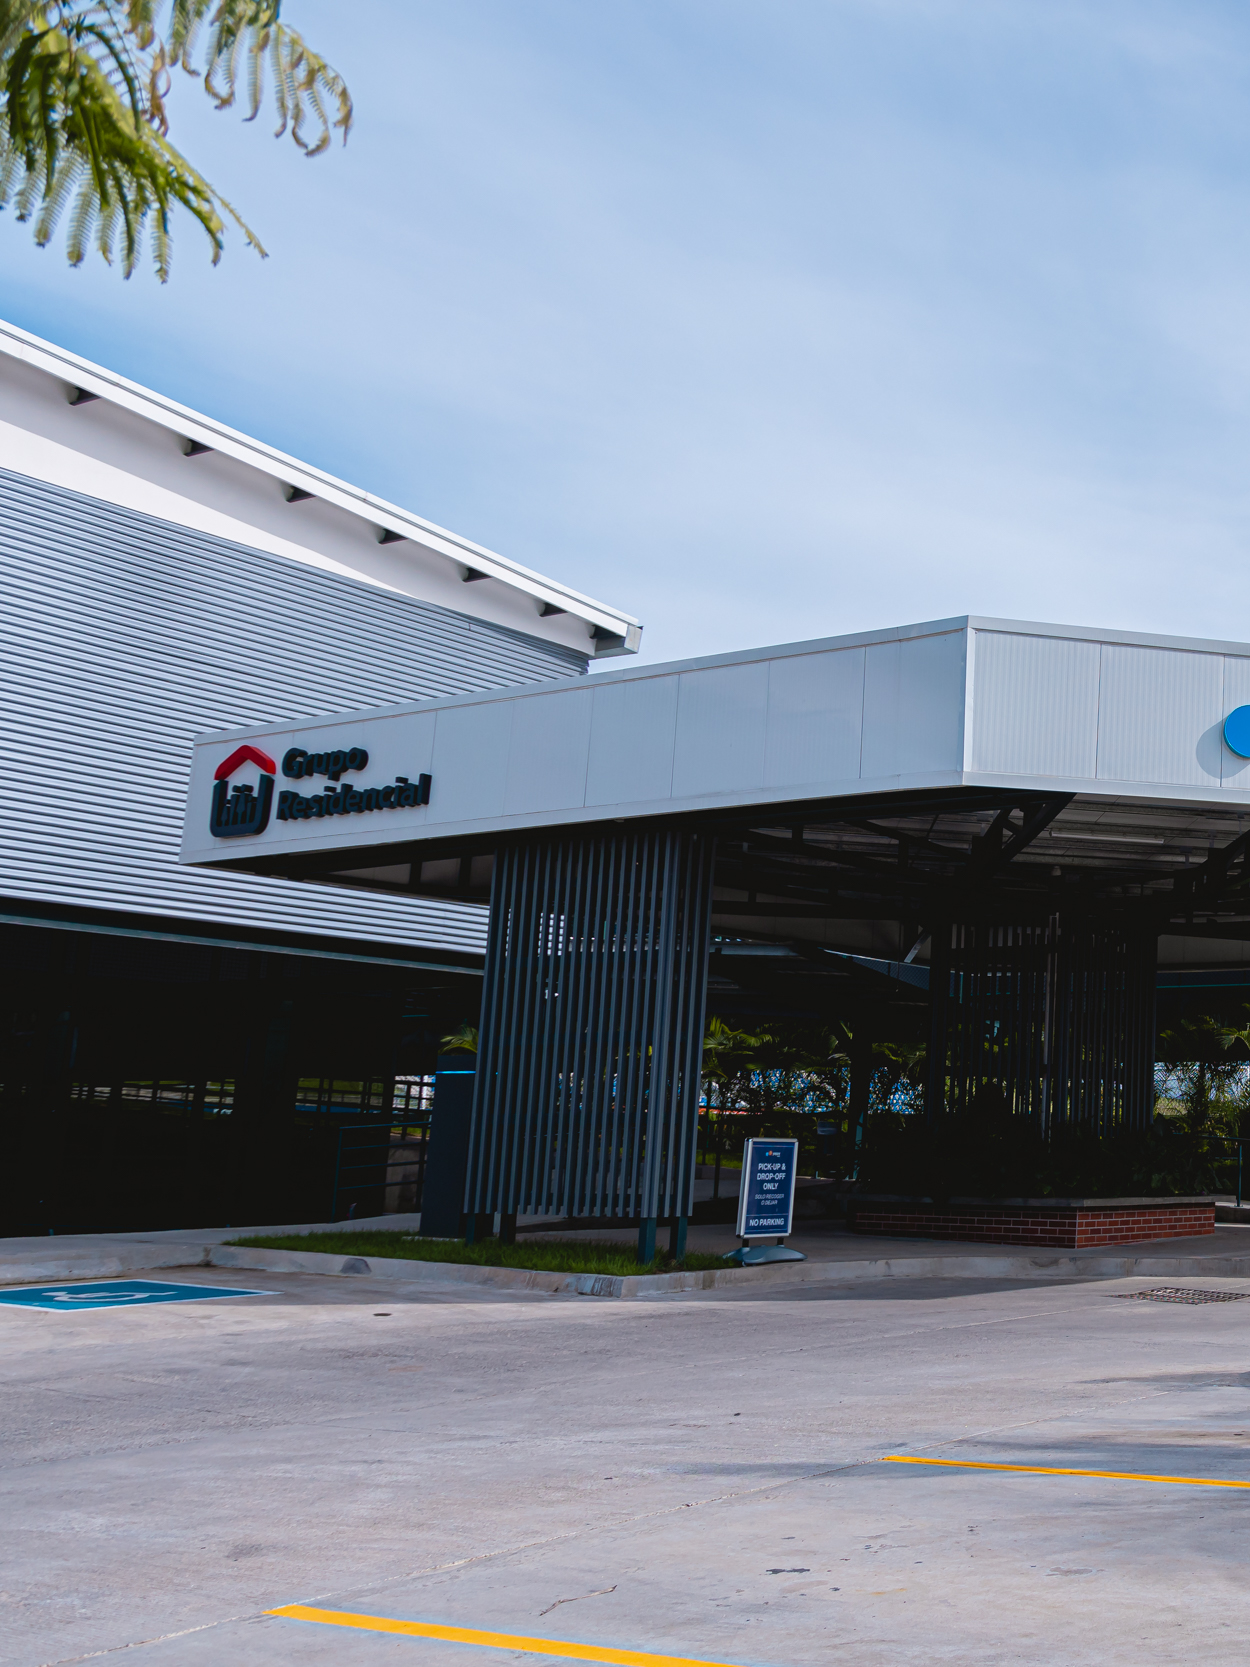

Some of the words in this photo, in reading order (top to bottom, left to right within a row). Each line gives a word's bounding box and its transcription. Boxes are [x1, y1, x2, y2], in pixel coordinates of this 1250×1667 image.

[282, 747, 369, 781] Grupo
[276, 773, 432, 821] Residencial
[763, 1182, 779, 1190] ONLY
[759, 1218, 784, 1226] PARKING
